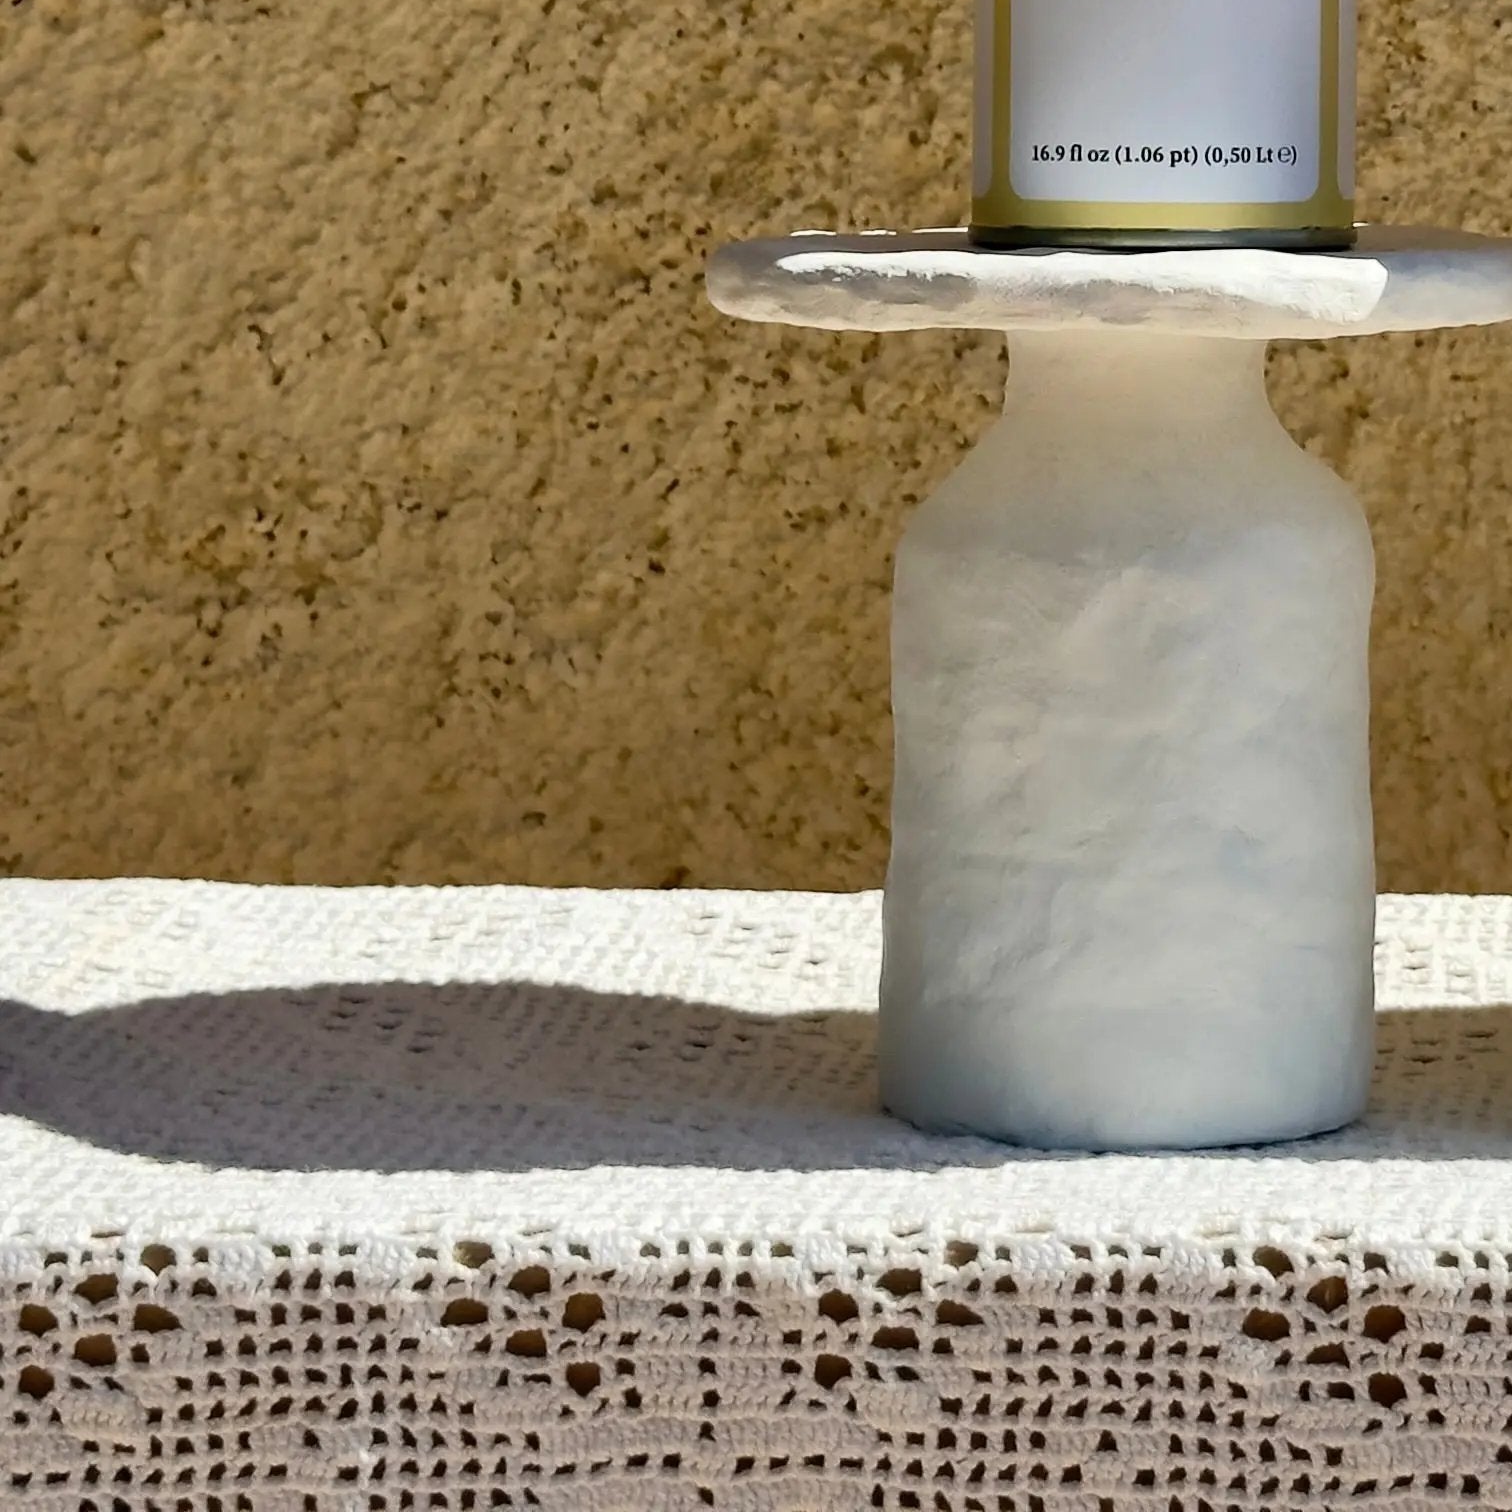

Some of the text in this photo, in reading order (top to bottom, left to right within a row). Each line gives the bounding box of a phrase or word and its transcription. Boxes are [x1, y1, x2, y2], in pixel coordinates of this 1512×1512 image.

[1032, 145, 1065, 161] 16.9
[1070, 144, 1082, 162] fl
[1088, 149, 1110, 162] oz
[1115, 145, 1164, 165] (1.06
[1170, 146, 1198, 168] pt)
[1205, 145, 1251, 167] (0,50
[1256, 147, 1273, 163] Lt
